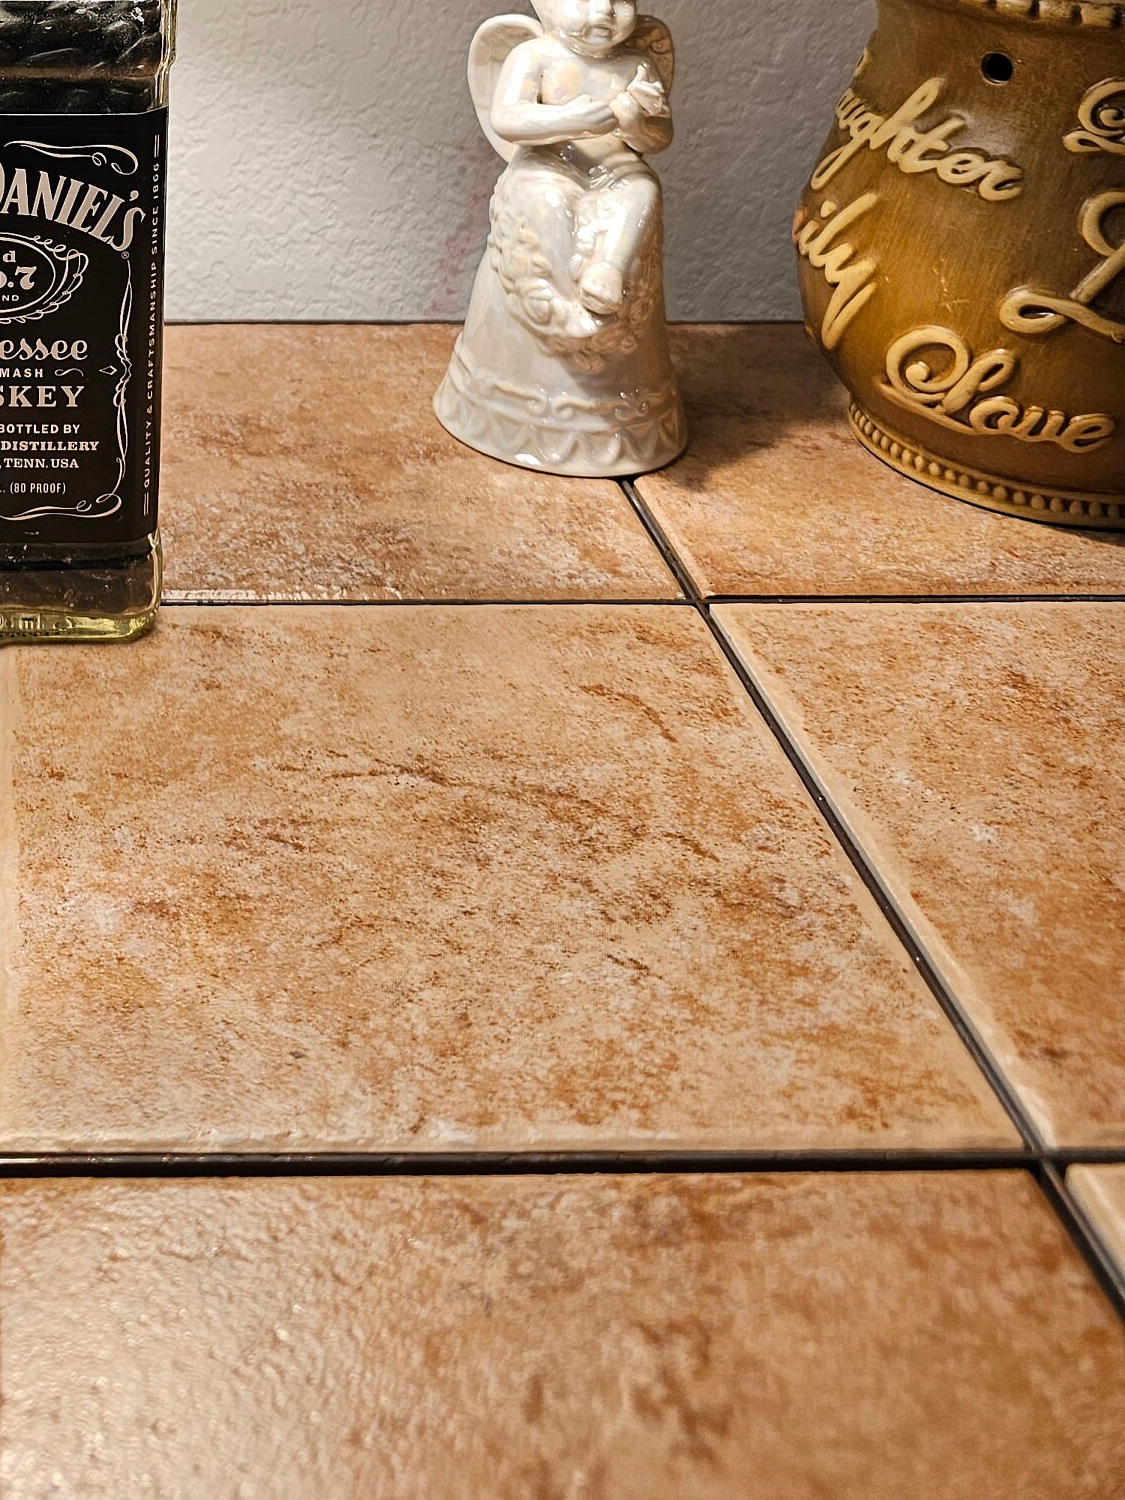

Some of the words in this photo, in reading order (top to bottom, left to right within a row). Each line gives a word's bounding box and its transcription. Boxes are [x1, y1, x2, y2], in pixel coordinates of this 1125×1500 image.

[810, 76, 1025, 202] ughter
[151, 205, 159, 255] SINCE
[794, 192, 879, 350] ily
[147, 262, 157, 400] CRAFTSMANSHIP
[878, 324, 1115, 453] Love
[0, 440, 100, 452] DISTILLERY
[63, 424, 81, 434] BY
[143, 420, 153, 488] QUALITY
[3, 458, 49, 468] TENN.
[51, 458, 80, 469] USA
[9, 481, 26, 494] (80
[30, 482, 67, 495] PROOF)
